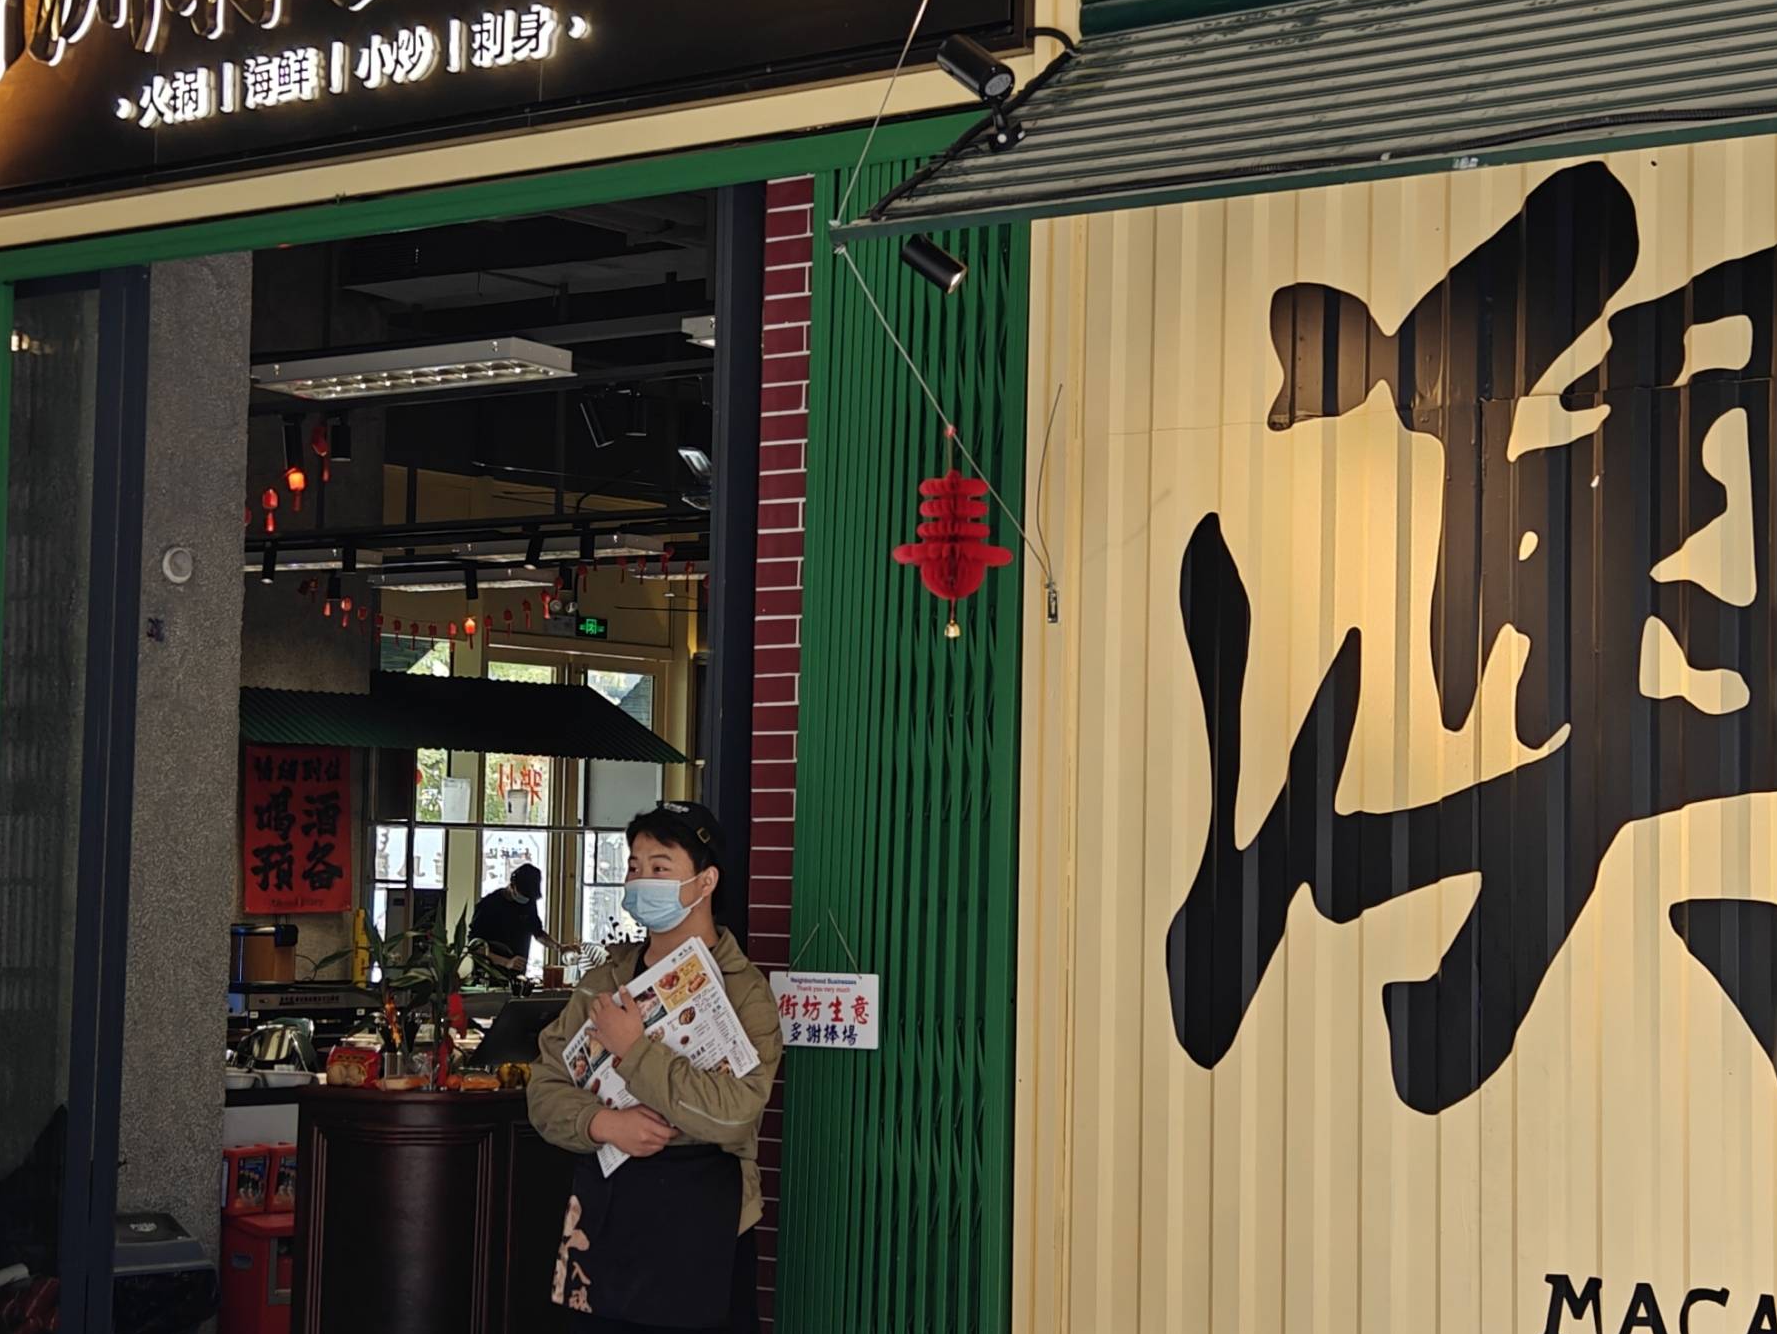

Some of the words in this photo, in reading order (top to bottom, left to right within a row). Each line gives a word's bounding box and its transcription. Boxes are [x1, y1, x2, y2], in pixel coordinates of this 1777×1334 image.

[138, 65, 213, 128] 火锅
[243, 46, 322, 109] 海鲜
[354, 24, 439, 89] 小炒
[470, 3, 559, 69] 刺身
[253, 786, 341, 841] 喝酒
[778, 993, 869, 1025] 街坊生意
[789, 1021, 858, 1047] 多謝捧場
